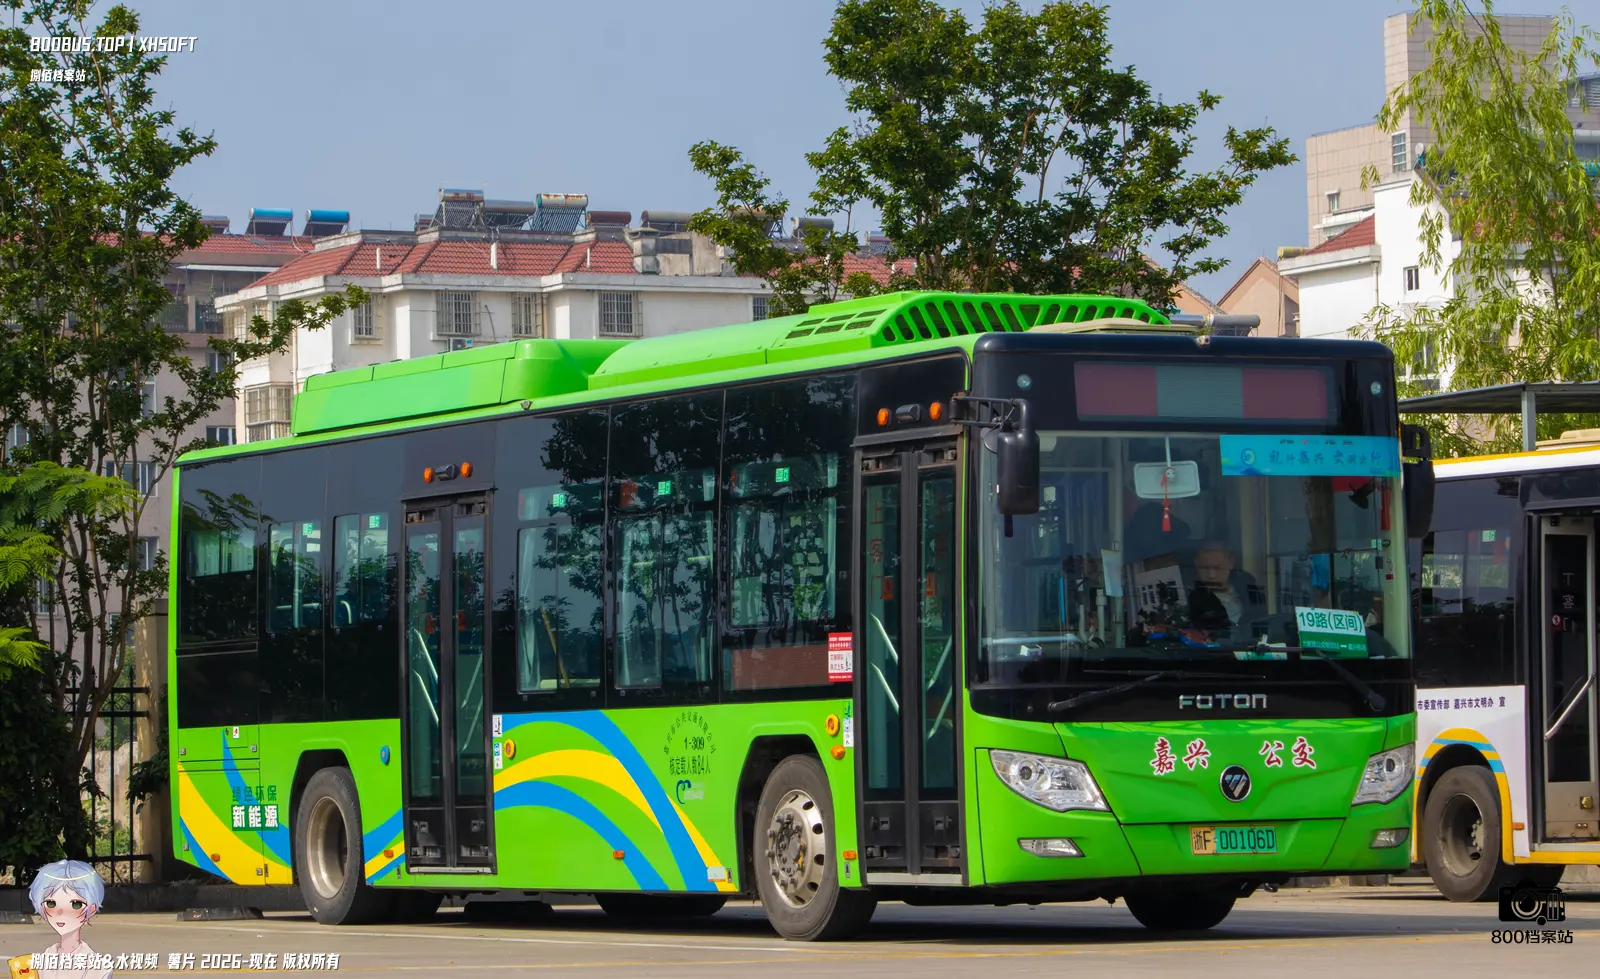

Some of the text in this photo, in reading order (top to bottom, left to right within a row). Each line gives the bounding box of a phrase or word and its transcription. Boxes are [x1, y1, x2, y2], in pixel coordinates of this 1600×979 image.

[1299, 611, 1363, 632] 19路(区间)
[1179, 694, 1267, 709] FOTON
[1417, 699, 1450, 711] 市委宣传部
[1453, 697, 1494, 710] 嘉兴市文明办
[1150, 737, 1317, 775] 嘉兴 公交
[232, 805, 278, 828] 新能源
